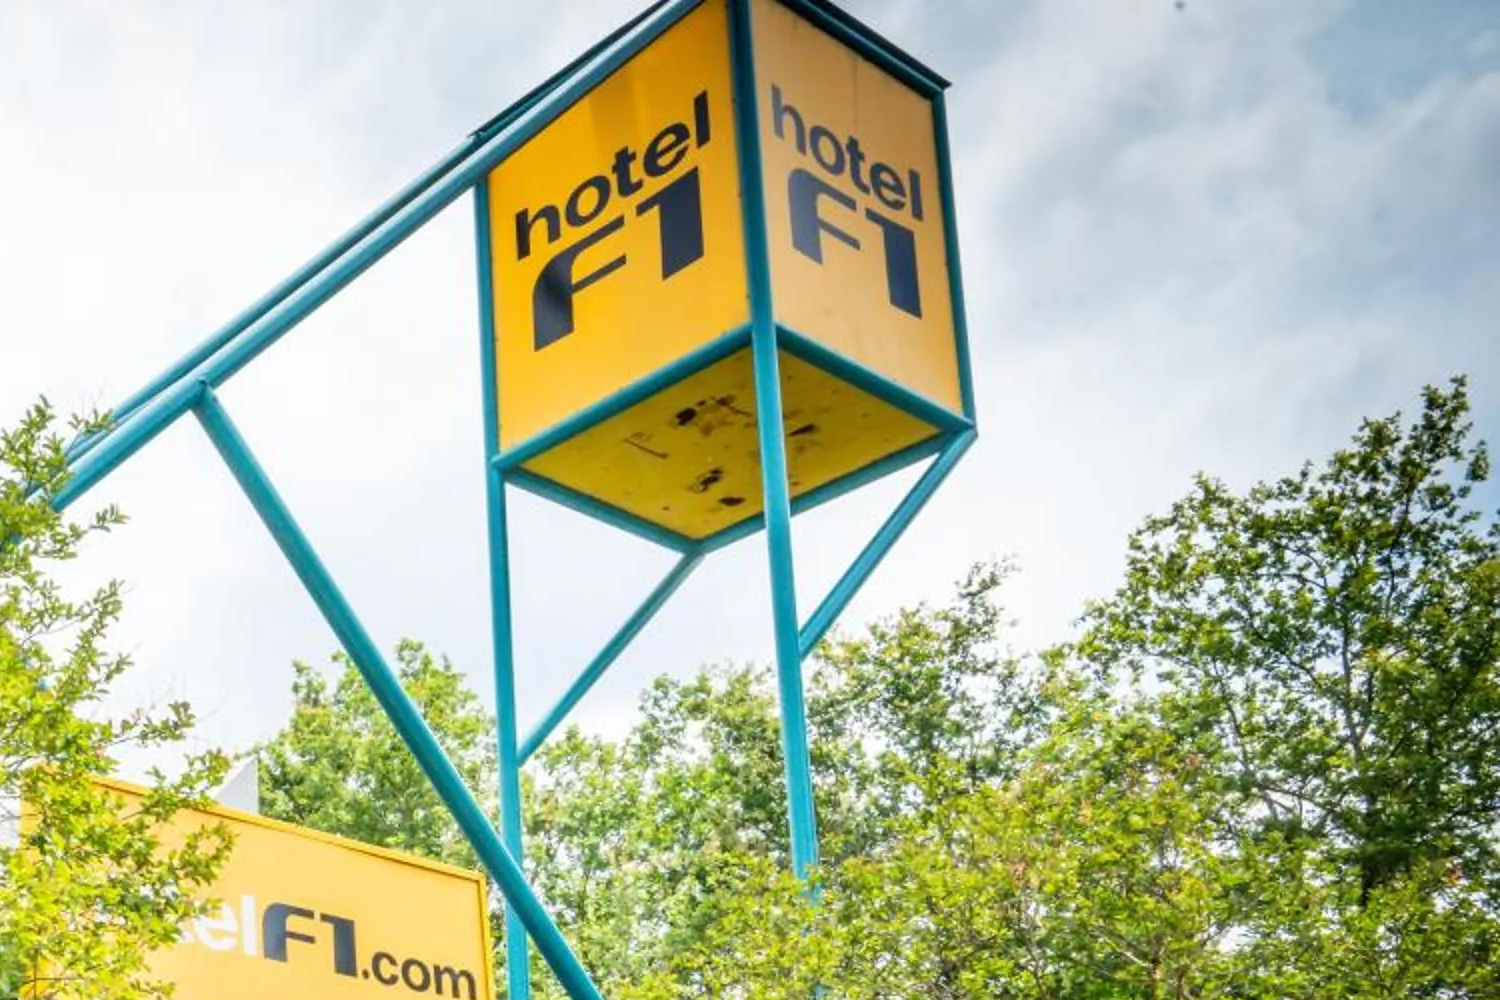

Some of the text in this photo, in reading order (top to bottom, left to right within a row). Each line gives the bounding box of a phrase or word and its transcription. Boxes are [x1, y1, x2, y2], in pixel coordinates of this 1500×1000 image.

[516, 89, 711, 261] hotel
[771, 83, 924, 222] hotel
[532, 166, 704, 352] F1
[787, 167, 922, 320] F1
